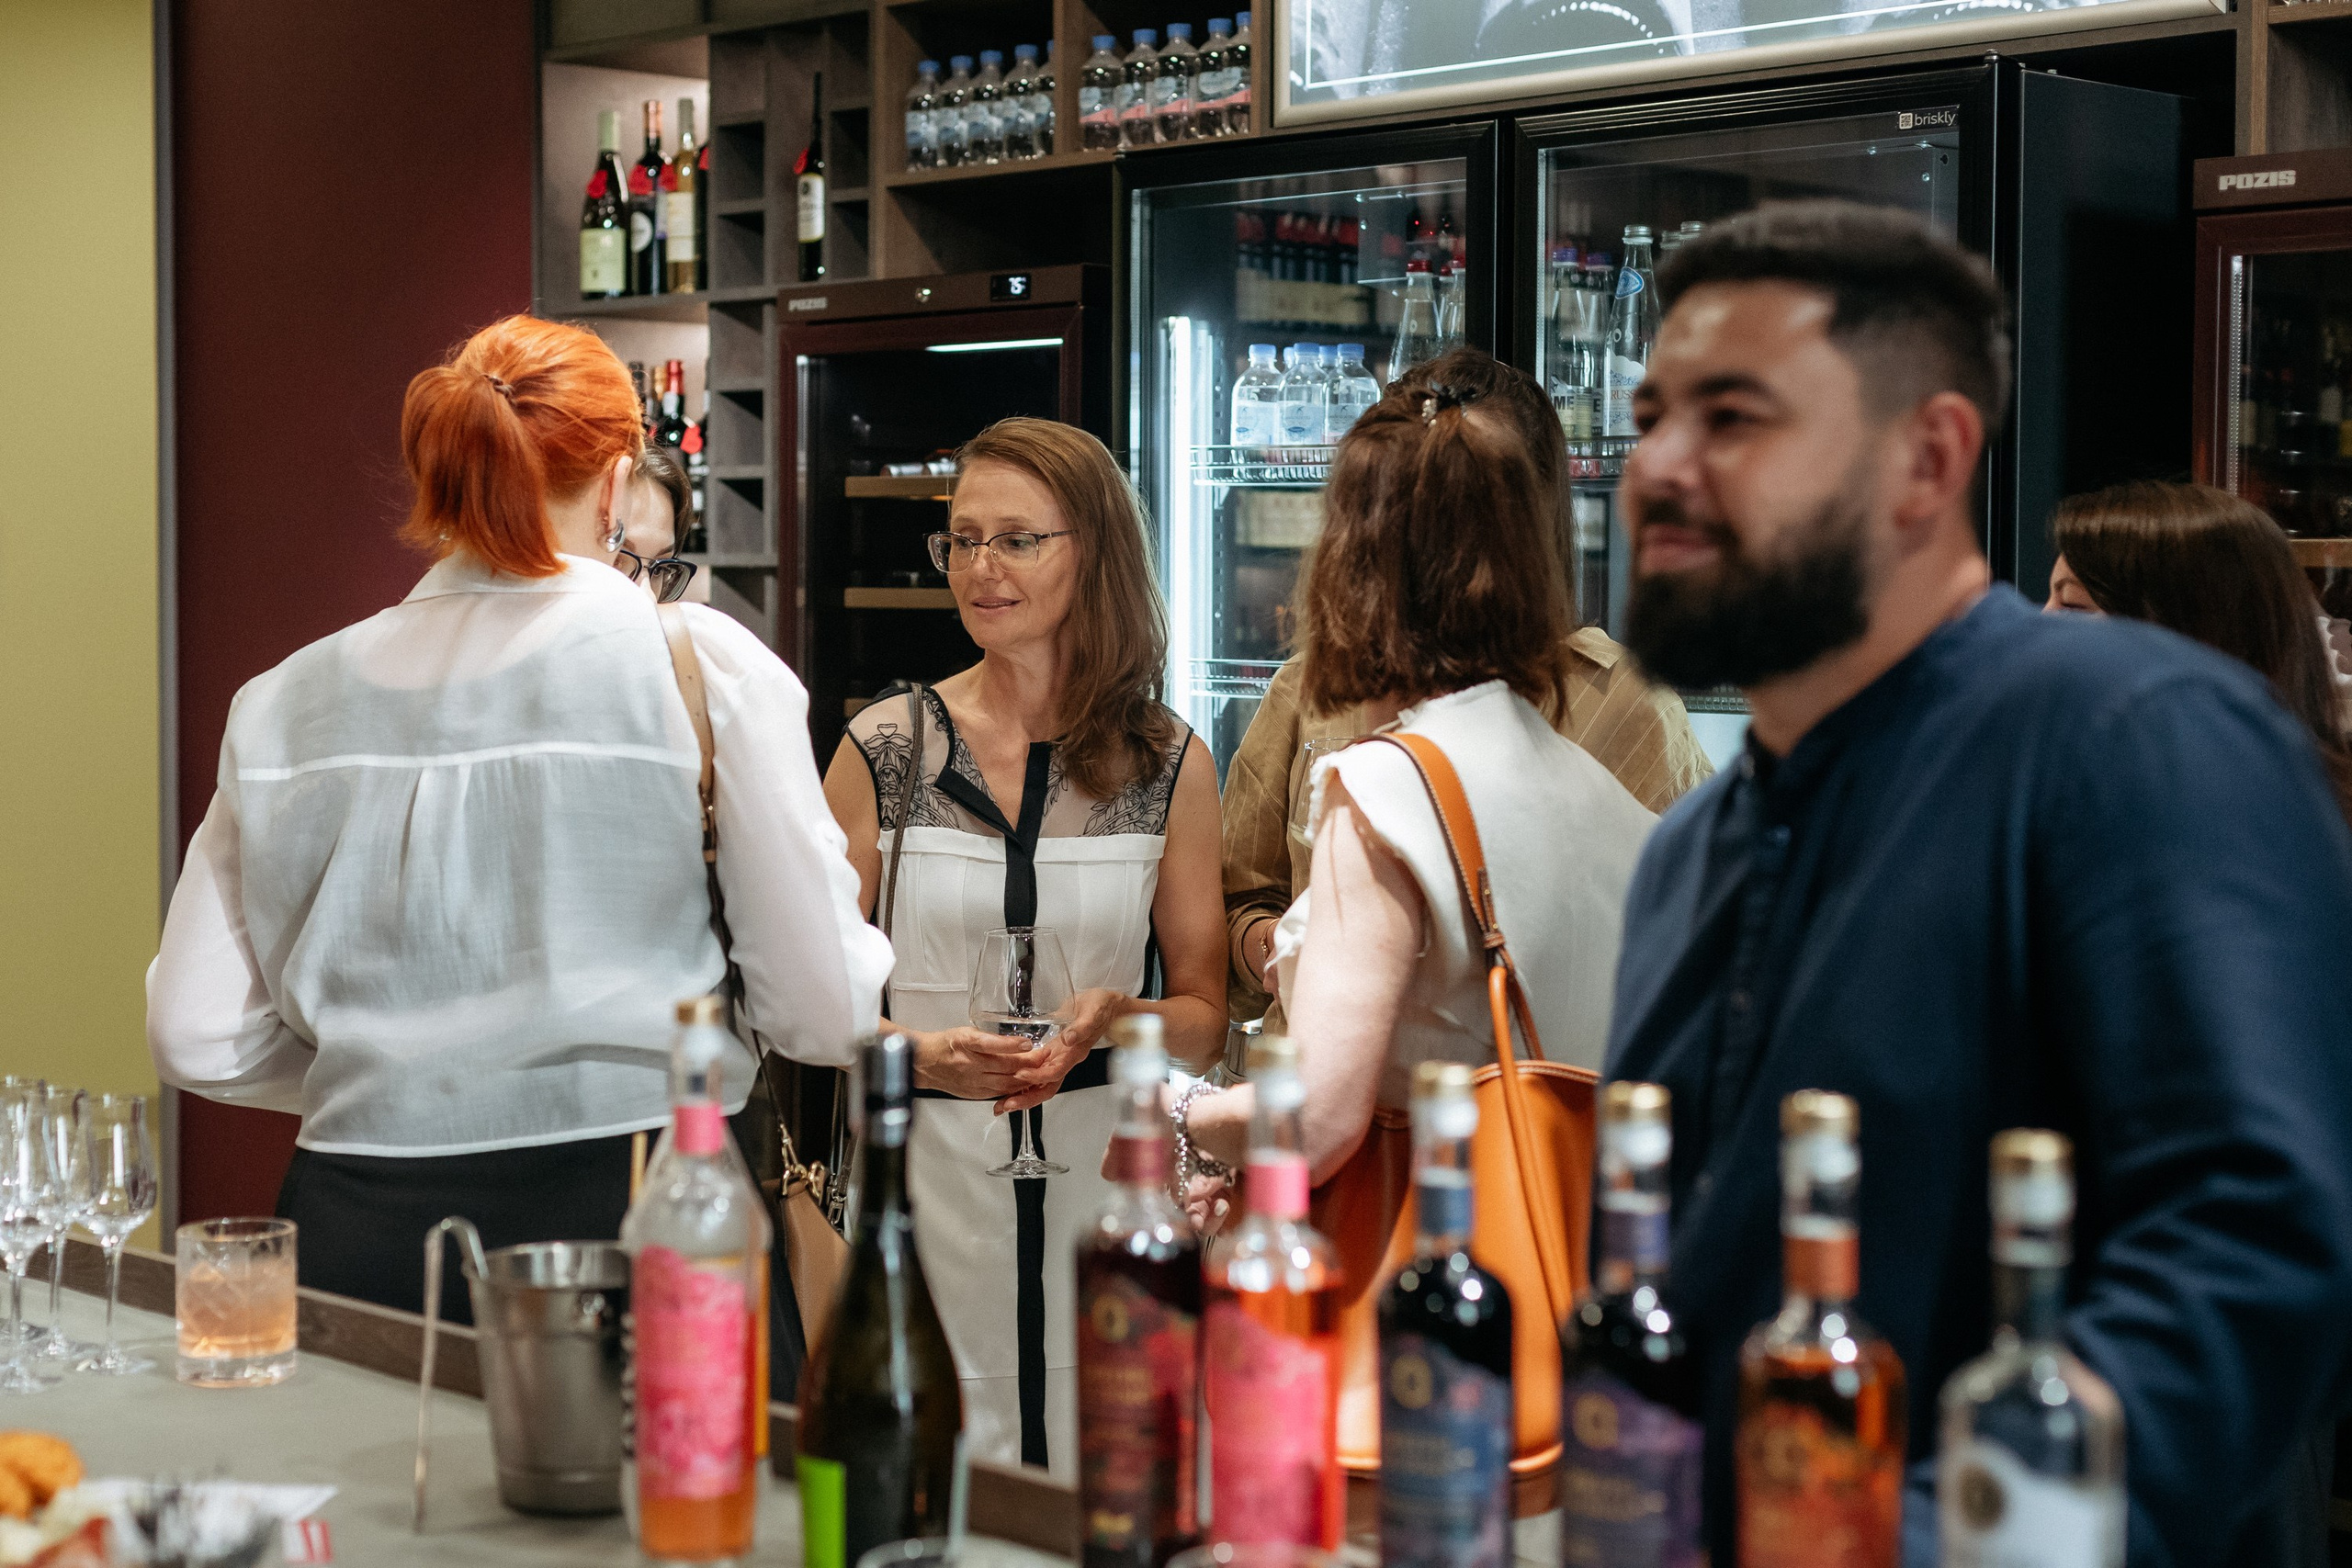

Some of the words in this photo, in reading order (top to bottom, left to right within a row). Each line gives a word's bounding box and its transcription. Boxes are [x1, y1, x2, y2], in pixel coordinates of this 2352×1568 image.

[1915, 111, 1956, 126] briskly
[2219, 170, 2296, 190] POZIS
[1611, 389, 1634, 400] RUSS
[1554, 396, 1574, 411] ME
